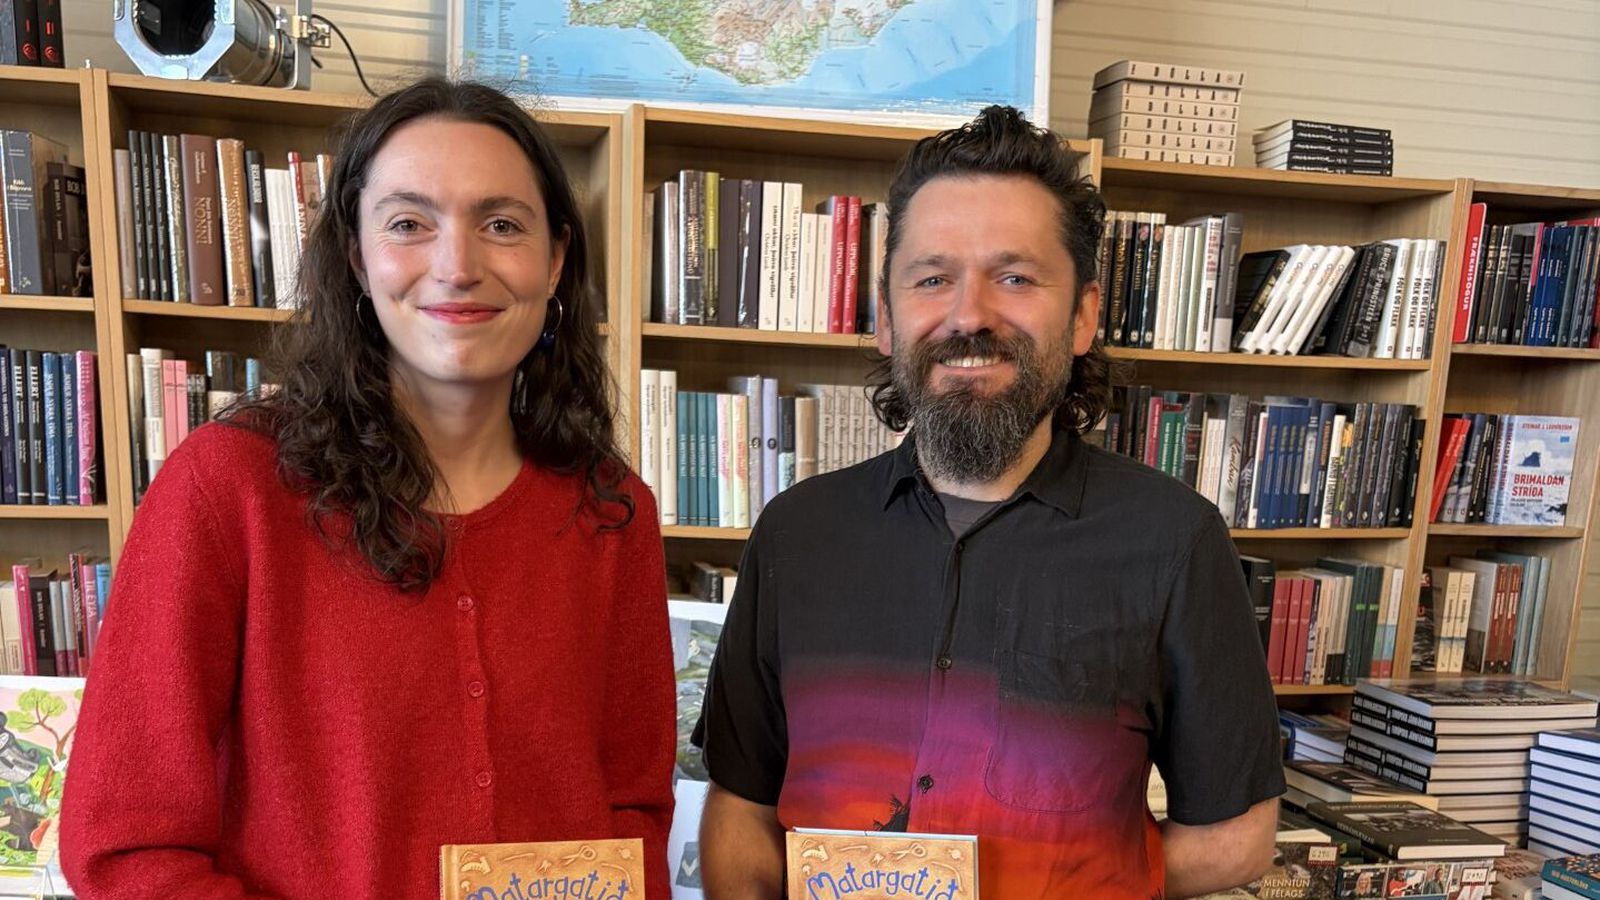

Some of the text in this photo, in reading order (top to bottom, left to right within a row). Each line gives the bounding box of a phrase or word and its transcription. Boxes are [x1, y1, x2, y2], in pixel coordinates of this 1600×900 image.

[194, 196, 206, 244] NONNI
[1364, 247, 1392, 322] BRUCE SPRINGSTEEN
[1412, 277, 1422, 295] FÓLK
[1423, 278, 1432, 295] FÓLK
[1394, 296, 1402, 305] OG
[1411, 296, 1419, 305] OG
[1422, 297, 1430, 305] OG
[14, 365, 23, 399] ELLERT
[30, 366, 39, 399] ELLERT
[1227, 436, 1242, 488] Kamban
[1514, 473, 1565, 485] BRIMALDAN
[1264, 879, 1310, 888] MENNTUN
